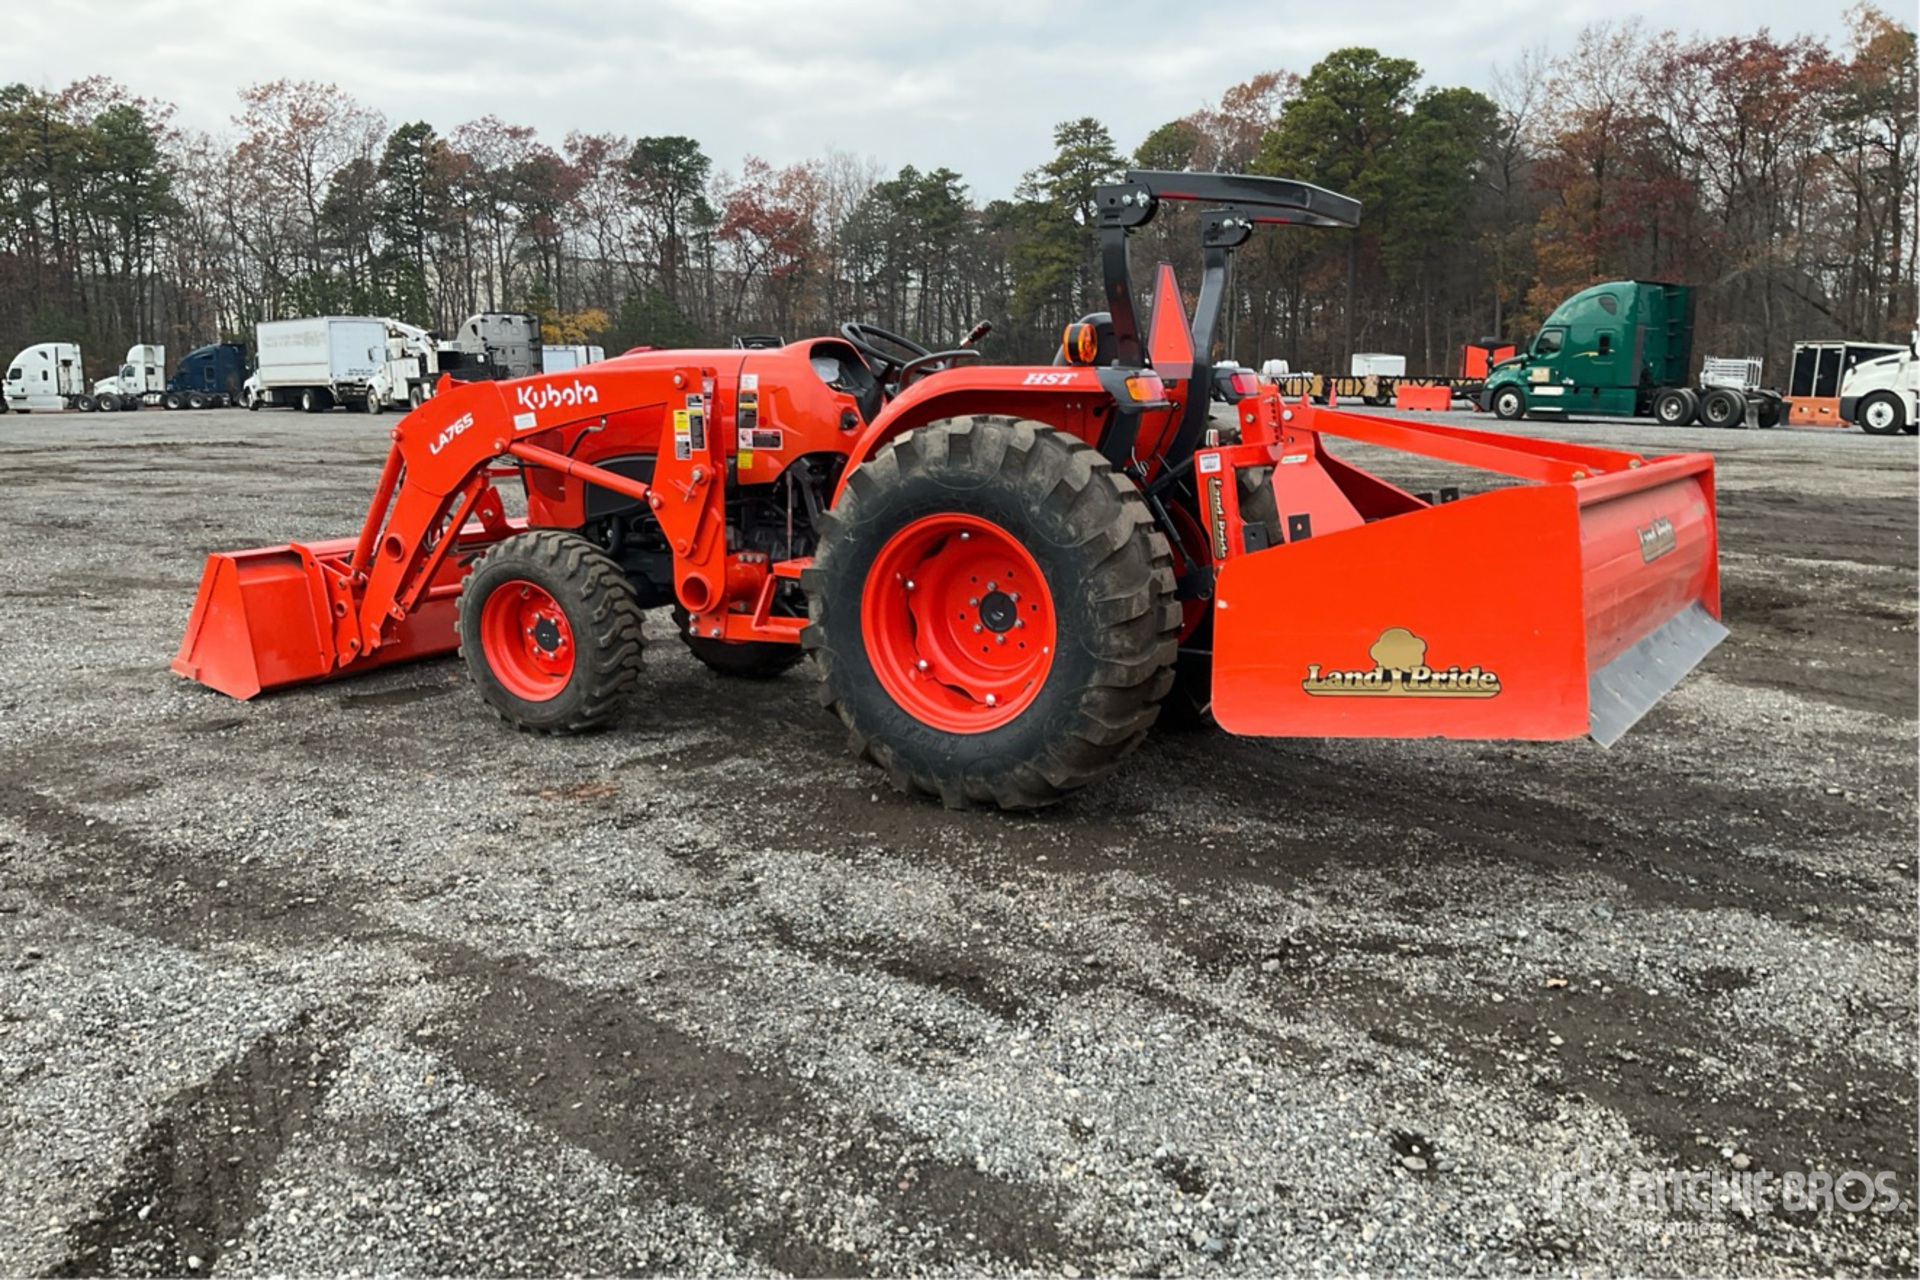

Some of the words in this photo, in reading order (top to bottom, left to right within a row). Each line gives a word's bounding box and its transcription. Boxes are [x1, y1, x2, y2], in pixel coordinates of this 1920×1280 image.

[1022, 372, 1078, 386] HST
[516, 379, 599, 410] Kubota
[429, 412, 475, 455] LA765
[1306, 664, 1386, 688] Land
[1407, 665, 1499, 690] Pride
